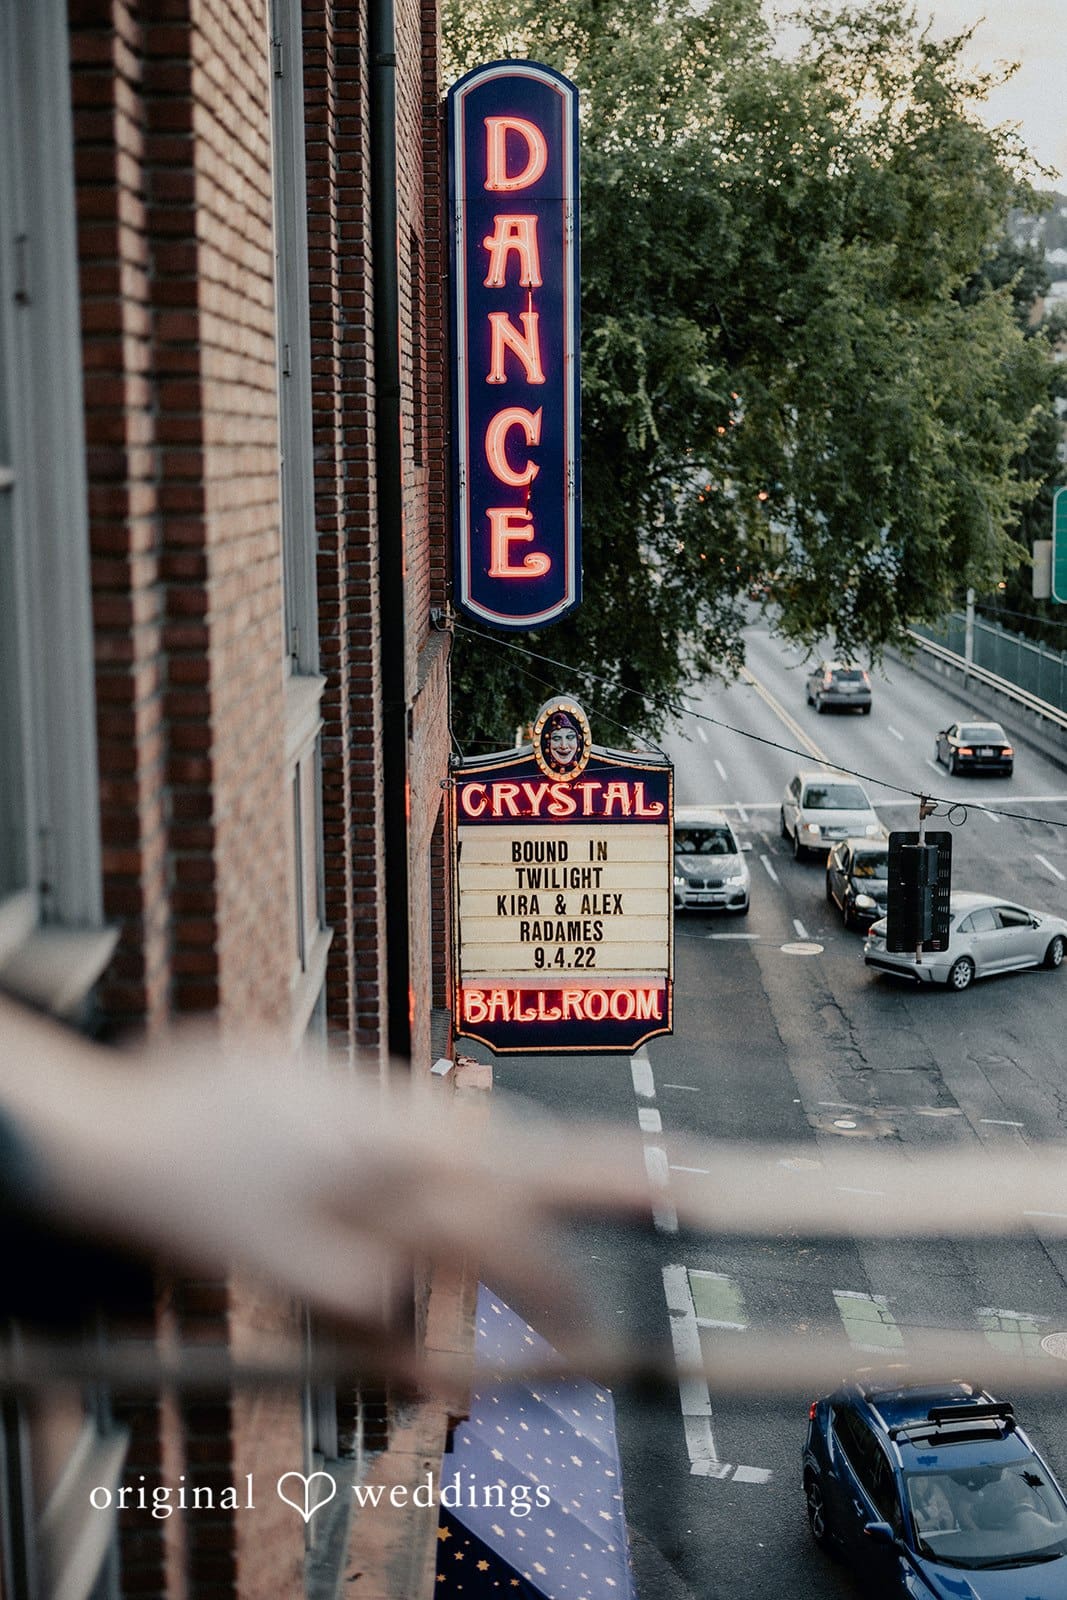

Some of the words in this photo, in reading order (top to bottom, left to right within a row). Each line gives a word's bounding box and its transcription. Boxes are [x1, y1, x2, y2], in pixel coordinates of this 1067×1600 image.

[484, 117, 551, 577] DANCE
[461, 782, 664, 817] CRYSTAL
[511, 841, 568, 862] BOUND
[589, 840, 608, 861] IN
[515, 867, 603, 889] TWILIGHT
[497, 894, 540, 916] KIRA
[554, 893, 567, 915] &
[581, 893, 624, 915] ALEX
[520, 920, 604, 942] RADAMES
[534, 947, 597, 968] 9.4.22
[463, 989, 662, 1023] BALLROOM
